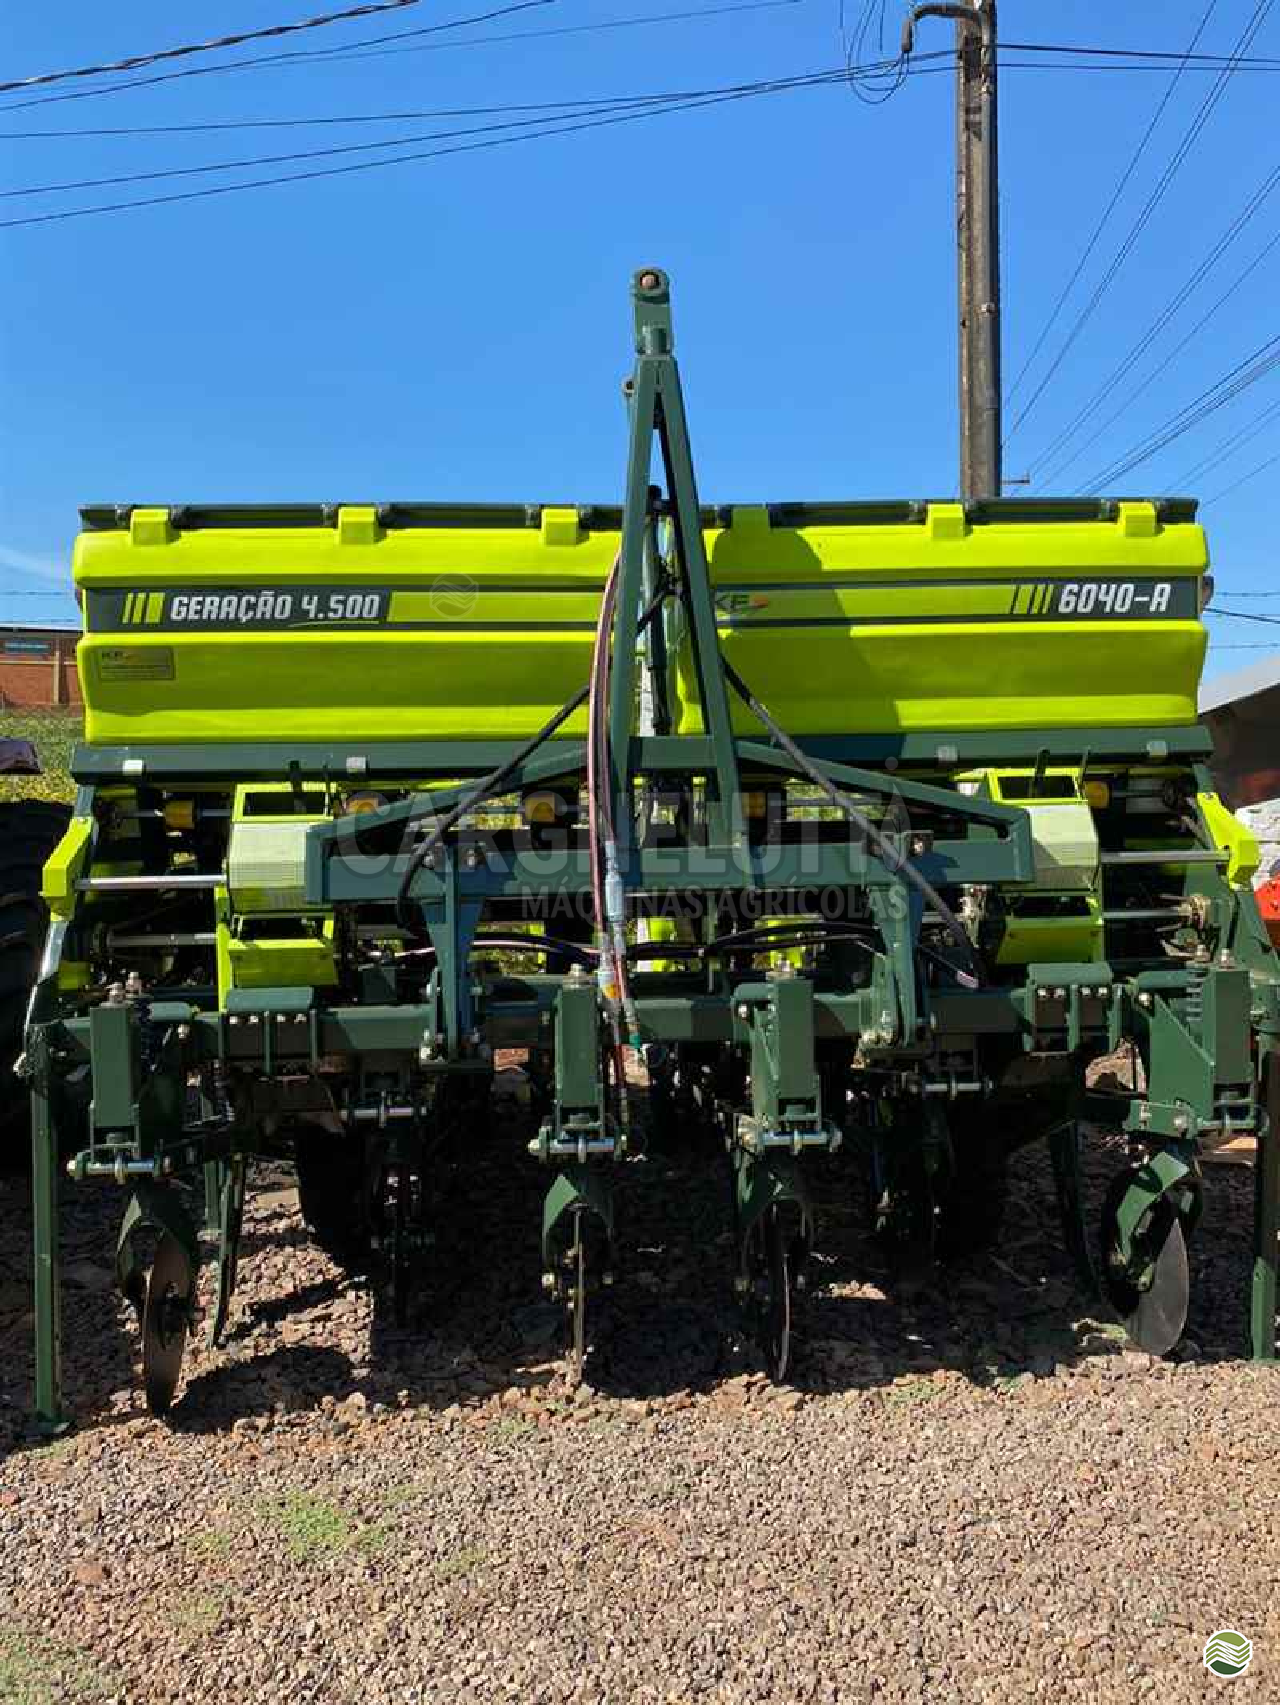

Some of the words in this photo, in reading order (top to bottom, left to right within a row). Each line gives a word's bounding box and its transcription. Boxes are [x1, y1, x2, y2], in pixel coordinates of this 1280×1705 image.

[170, 591, 292, 622] GERAÇÃO
[301, 594, 380, 618] 4.500
[1058, 583, 1171, 613] 6040-A
